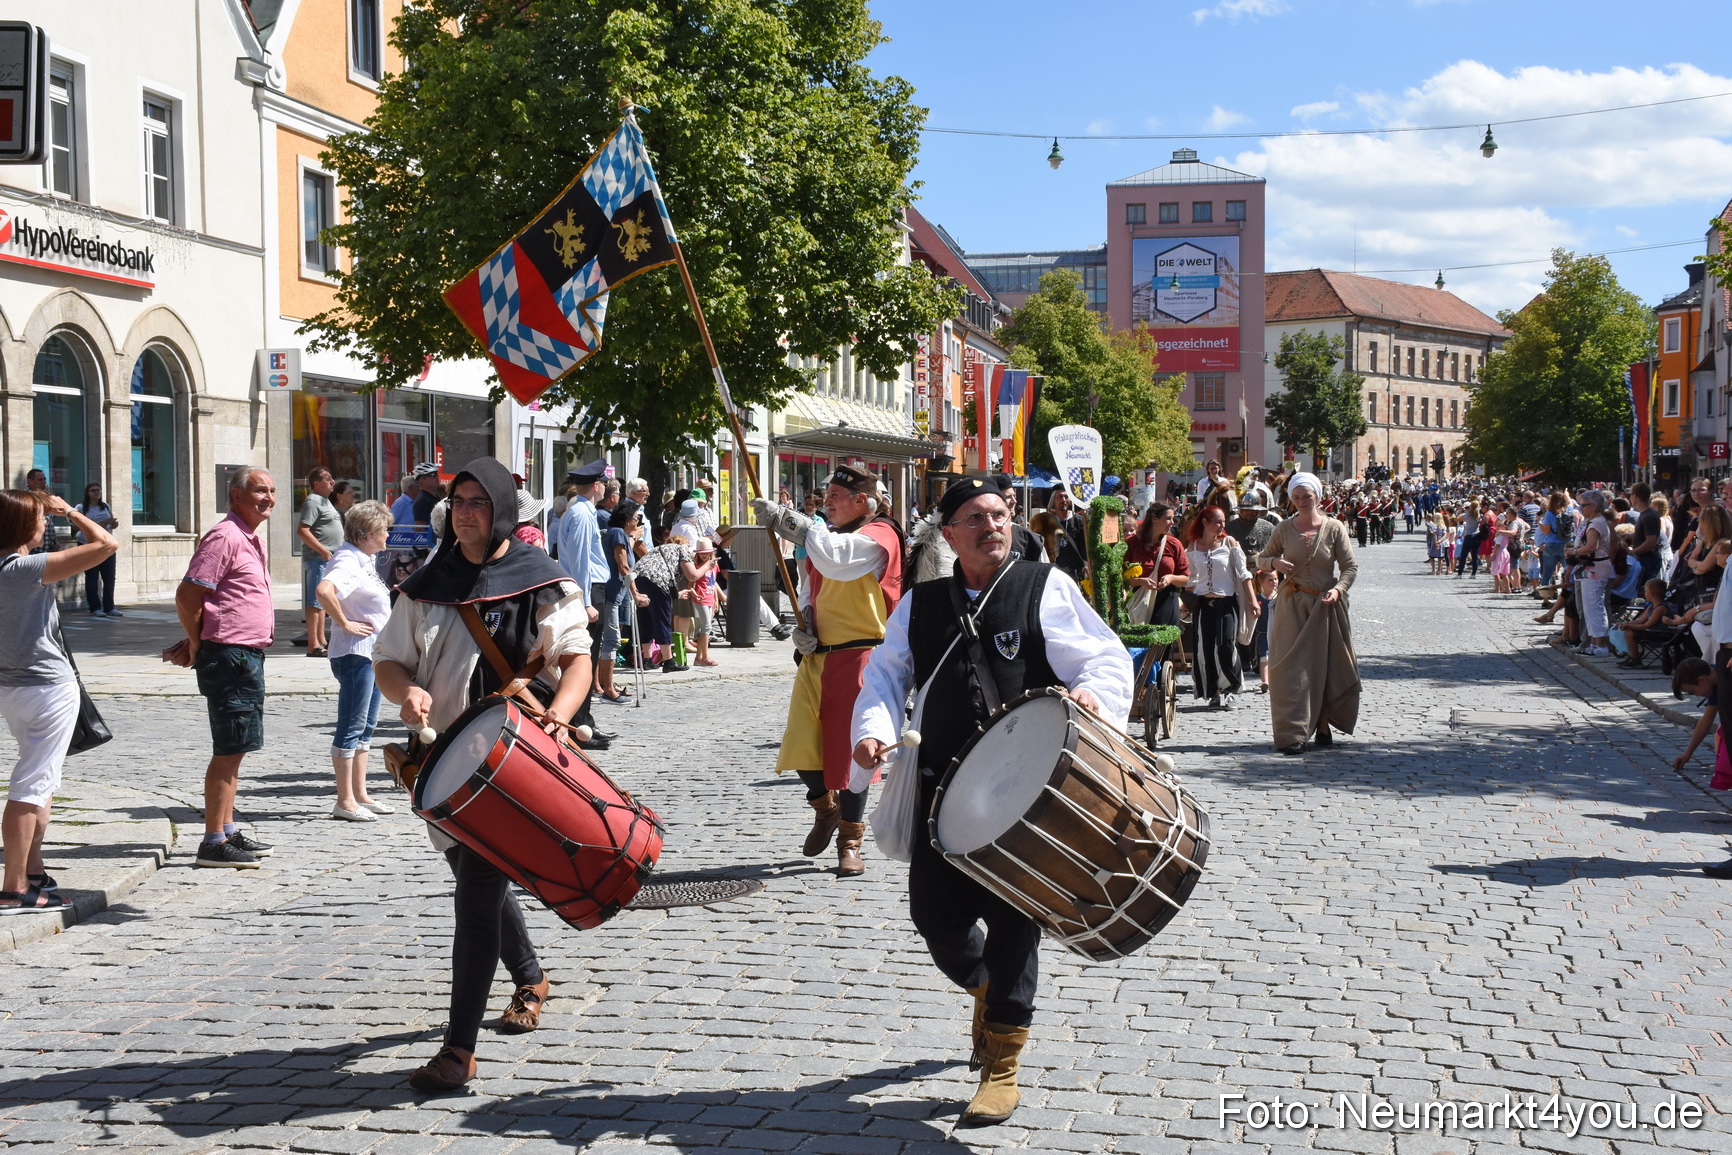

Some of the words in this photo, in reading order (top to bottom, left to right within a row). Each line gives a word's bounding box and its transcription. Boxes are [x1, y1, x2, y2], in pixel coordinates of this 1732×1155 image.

[14, 216, 155, 273] HypoVereinsbank
[1158, 259, 1175, 267] DIE
[1713, 444, 1724, 456] T
